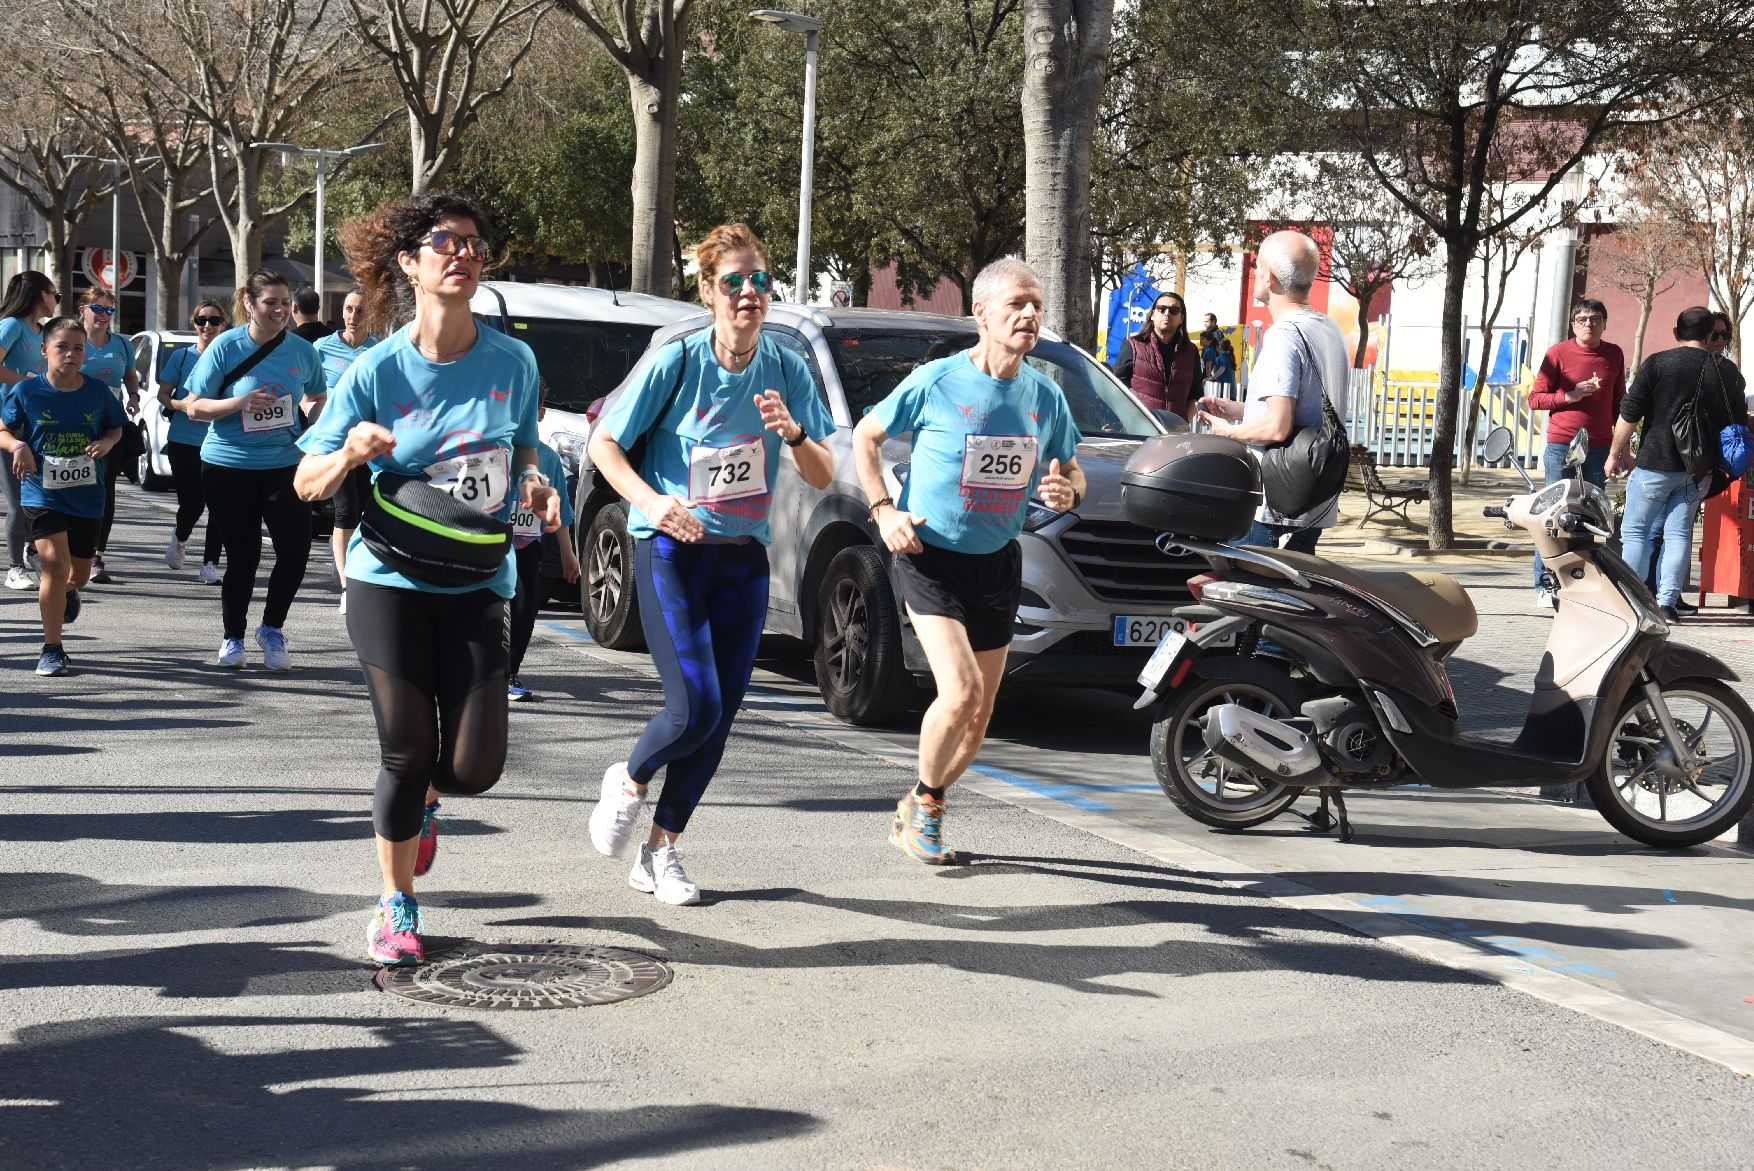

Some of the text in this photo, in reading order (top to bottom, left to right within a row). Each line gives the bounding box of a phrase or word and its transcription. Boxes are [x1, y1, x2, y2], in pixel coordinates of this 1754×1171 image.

[49, 466, 91, 481] 1008
[708, 461, 751, 487] 732
[979, 453, 1022, 476] 256
[509, 512, 534, 527] 900
